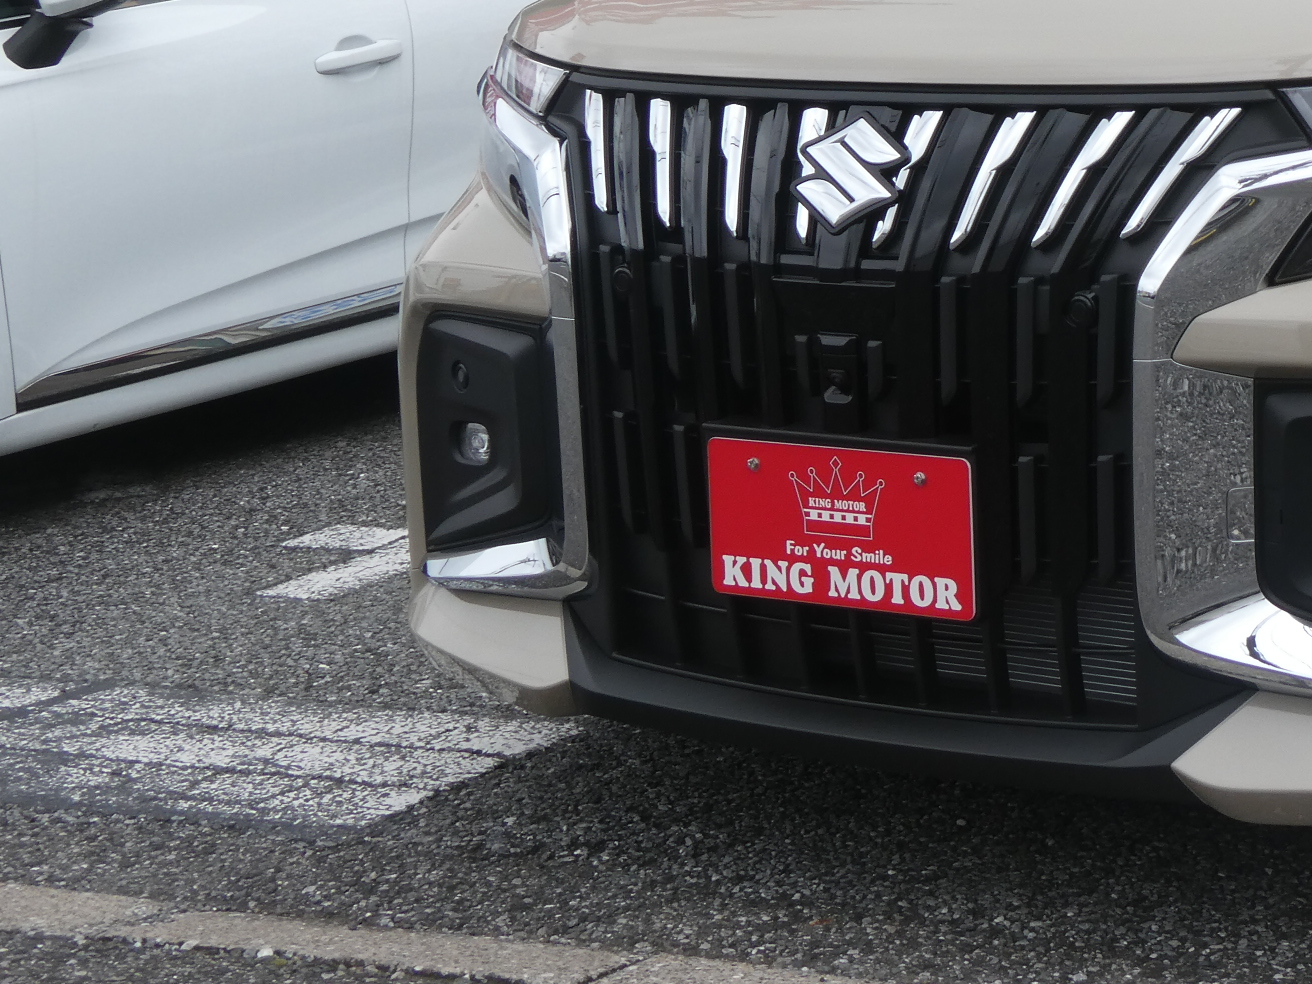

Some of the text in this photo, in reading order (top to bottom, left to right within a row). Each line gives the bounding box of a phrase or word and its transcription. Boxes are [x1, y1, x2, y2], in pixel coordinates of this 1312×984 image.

[808, 497, 867, 512] KING MOTOR
[786, 539, 893, 565] For Your Smile
[721, 554, 963, 611] KING MOTOR
